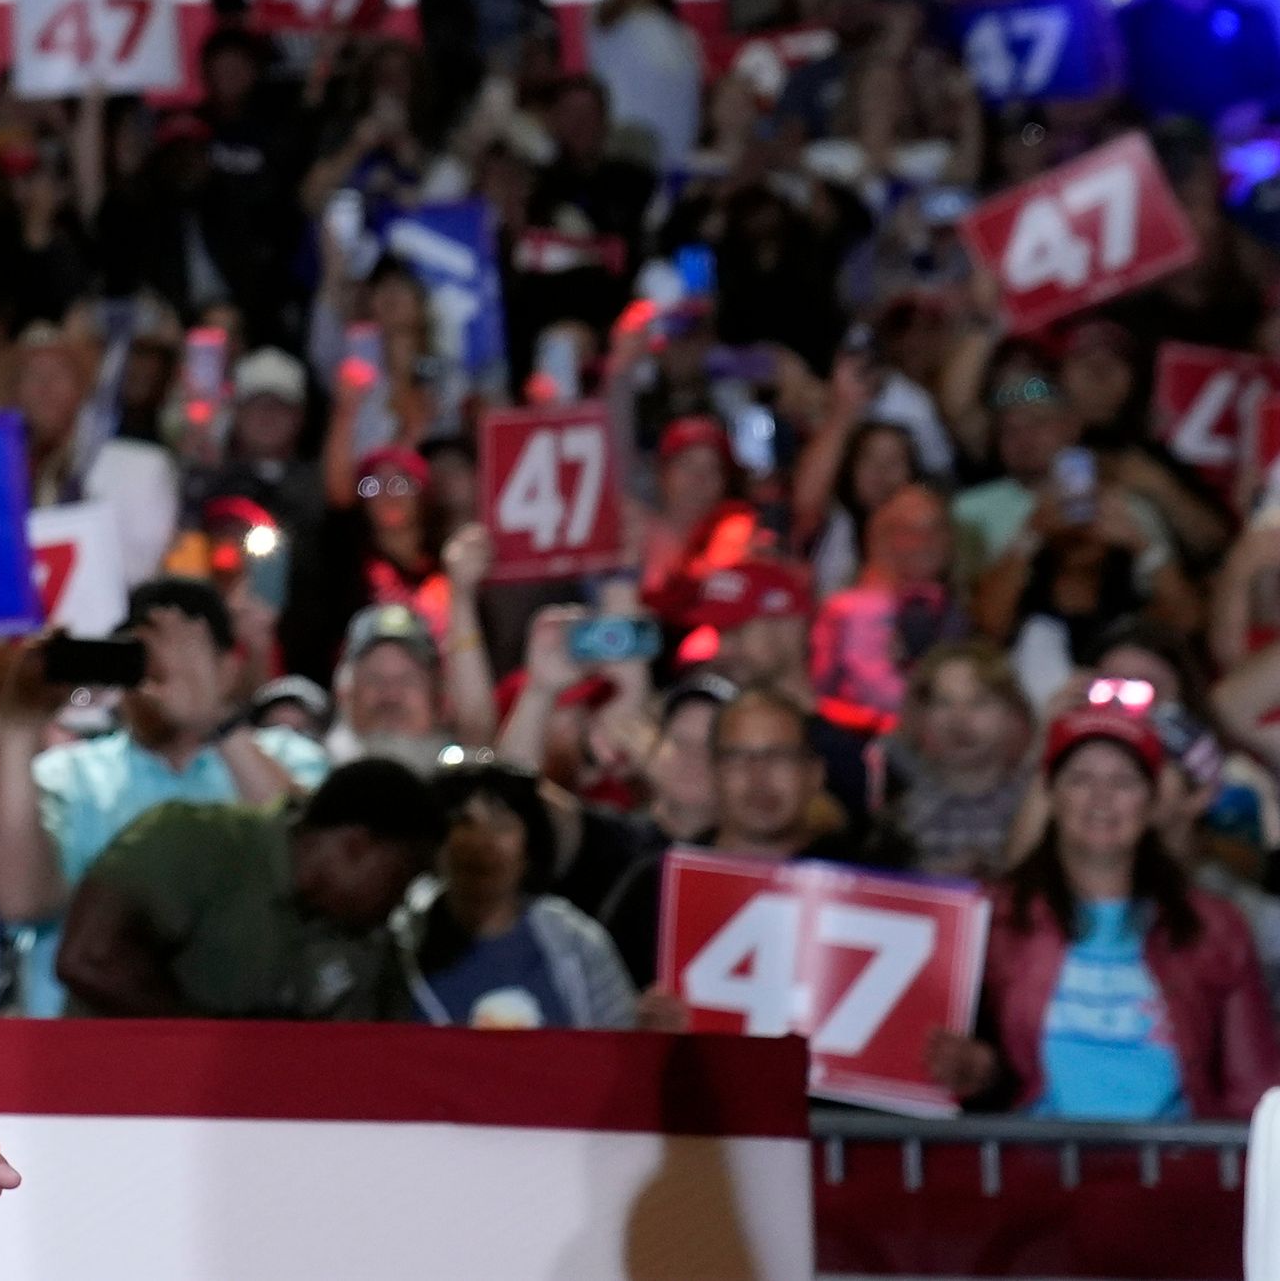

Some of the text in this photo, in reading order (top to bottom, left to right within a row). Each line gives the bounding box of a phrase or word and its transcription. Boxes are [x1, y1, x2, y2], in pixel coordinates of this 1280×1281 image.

[964, 7, 1067, 94] 47
[1004, 164, 1137, 290] 47
[1173, 368, 1245, 464] 4
[498, 425, 607, 550] 47
[683, 895, 936, 1057] 47
